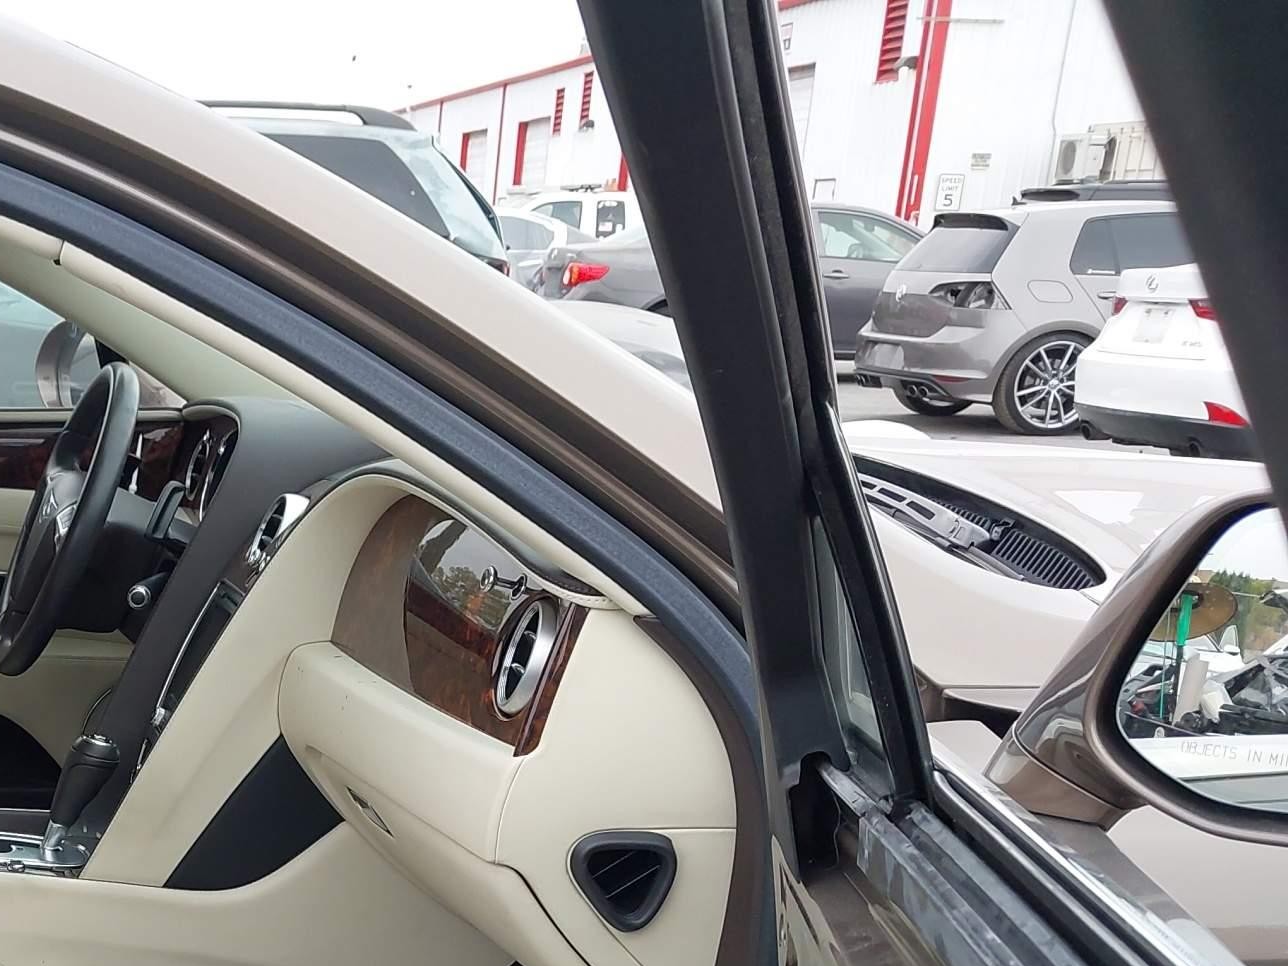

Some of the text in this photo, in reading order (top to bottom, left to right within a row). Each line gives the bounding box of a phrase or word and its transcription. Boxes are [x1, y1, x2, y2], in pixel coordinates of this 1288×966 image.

[943, 193, 953, 207] 5
[1181, 741, 1288, 768] OBJECTS IN MI
